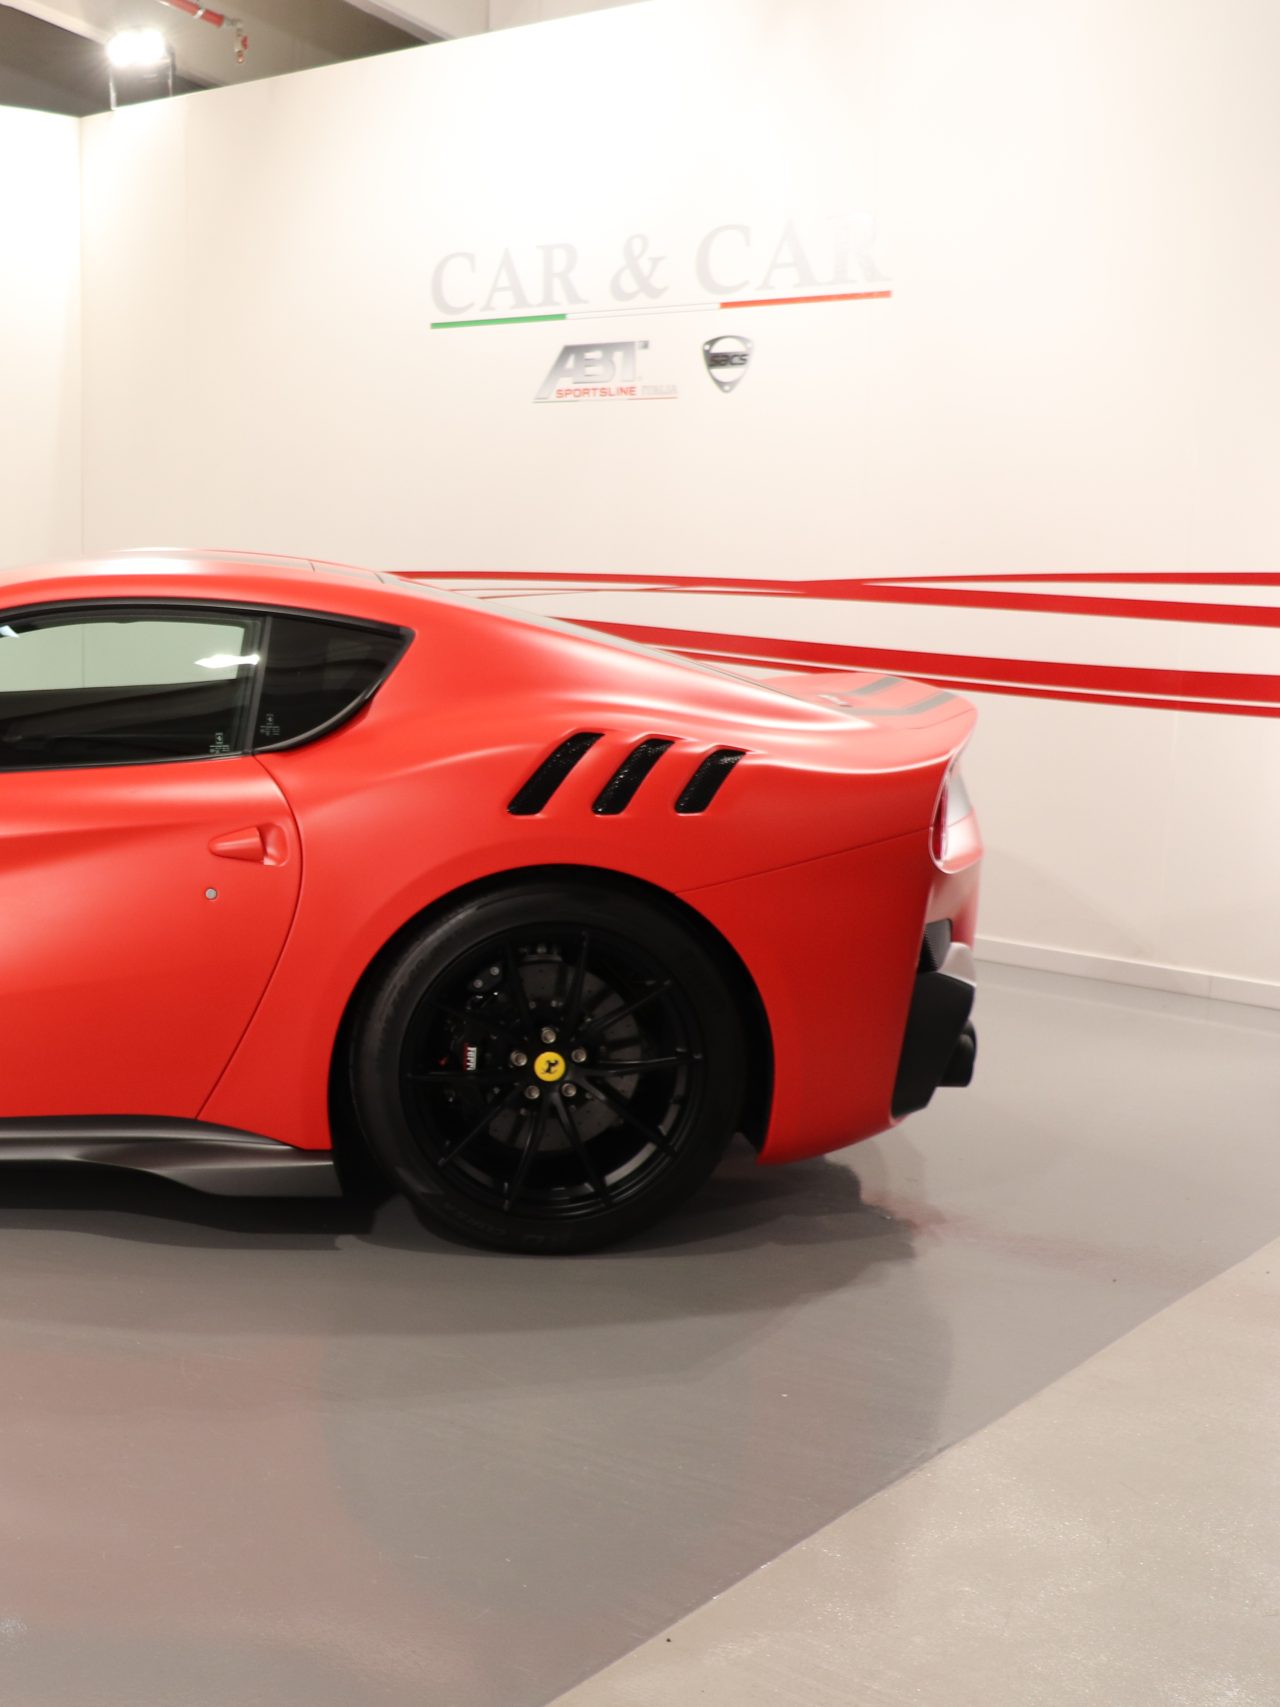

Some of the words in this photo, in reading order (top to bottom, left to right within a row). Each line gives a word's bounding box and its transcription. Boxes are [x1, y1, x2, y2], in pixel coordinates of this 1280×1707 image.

[430, 243, 589, 316] CAR
[609, 233, 671, 303] &
[695, 212, 893, 296] CAR
[533, 341, 638, 401] ABT
[555, 386, 637, 398] SPORTSLINE
